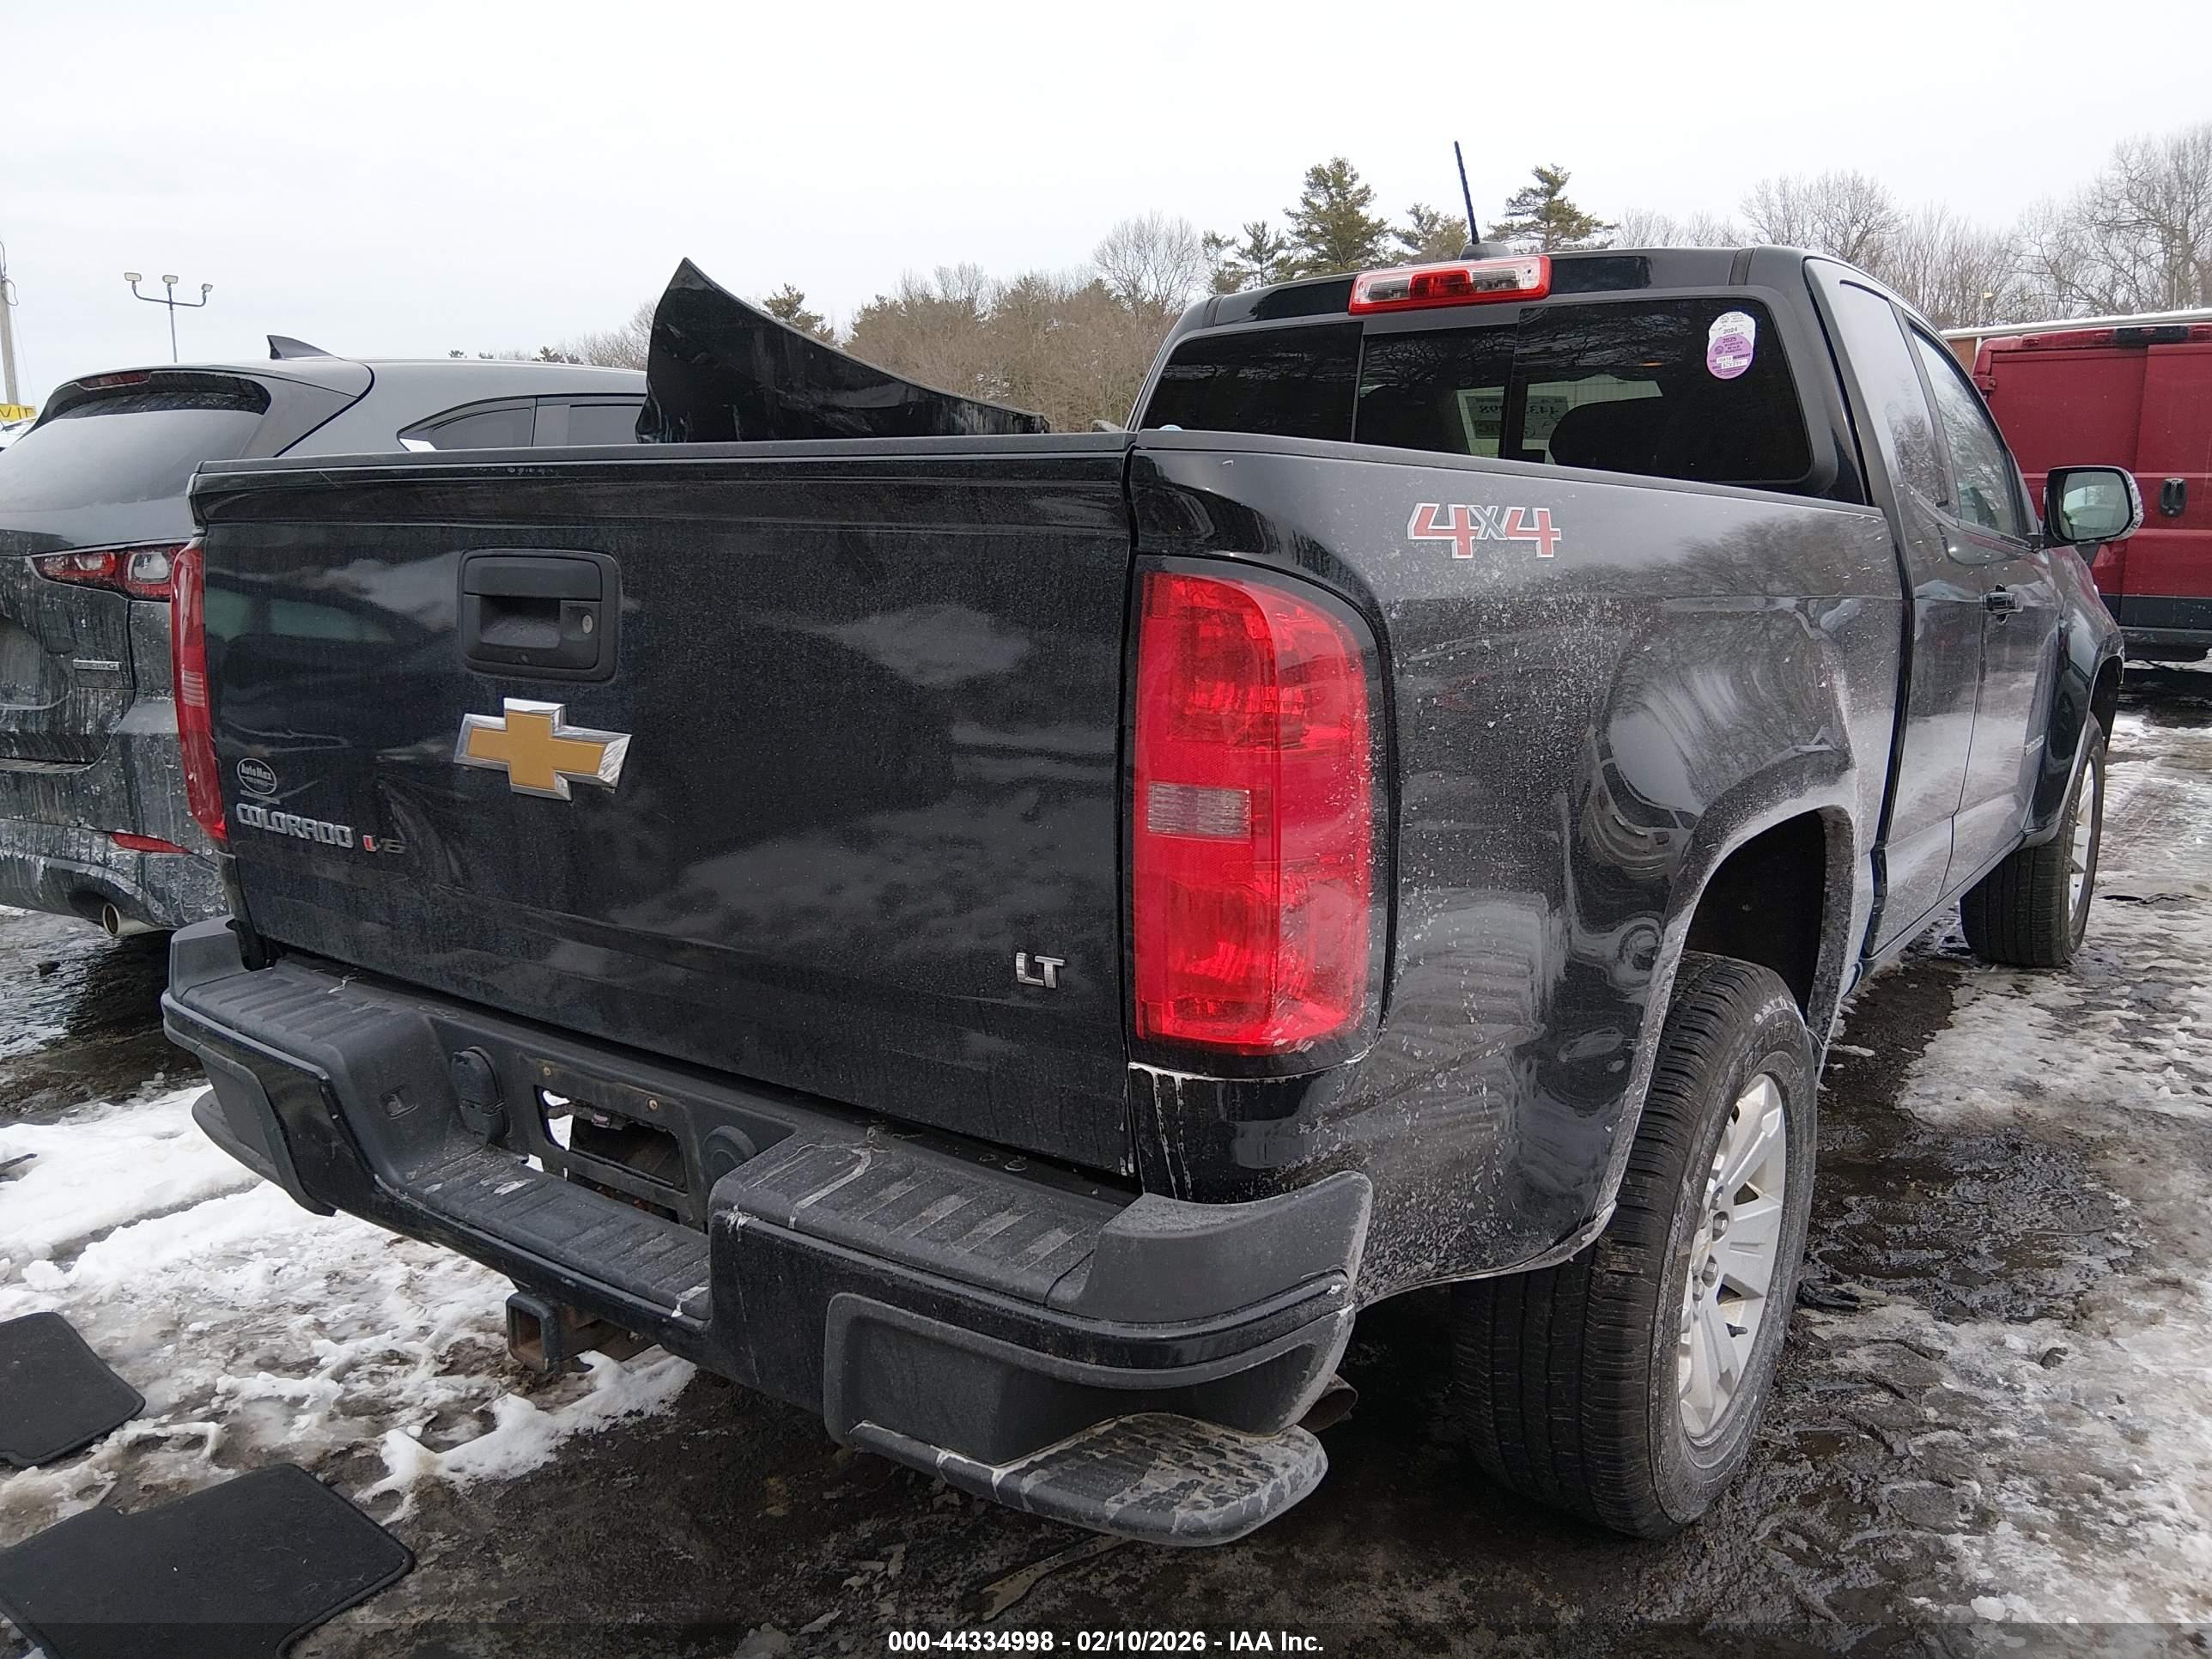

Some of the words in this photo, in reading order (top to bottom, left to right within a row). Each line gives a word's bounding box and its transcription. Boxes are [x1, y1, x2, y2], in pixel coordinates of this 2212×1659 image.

[236, 803, 355, 848] COLORADO
[362, 834, 405, 854] V6
[1015, 952, 1066, 988] LT
